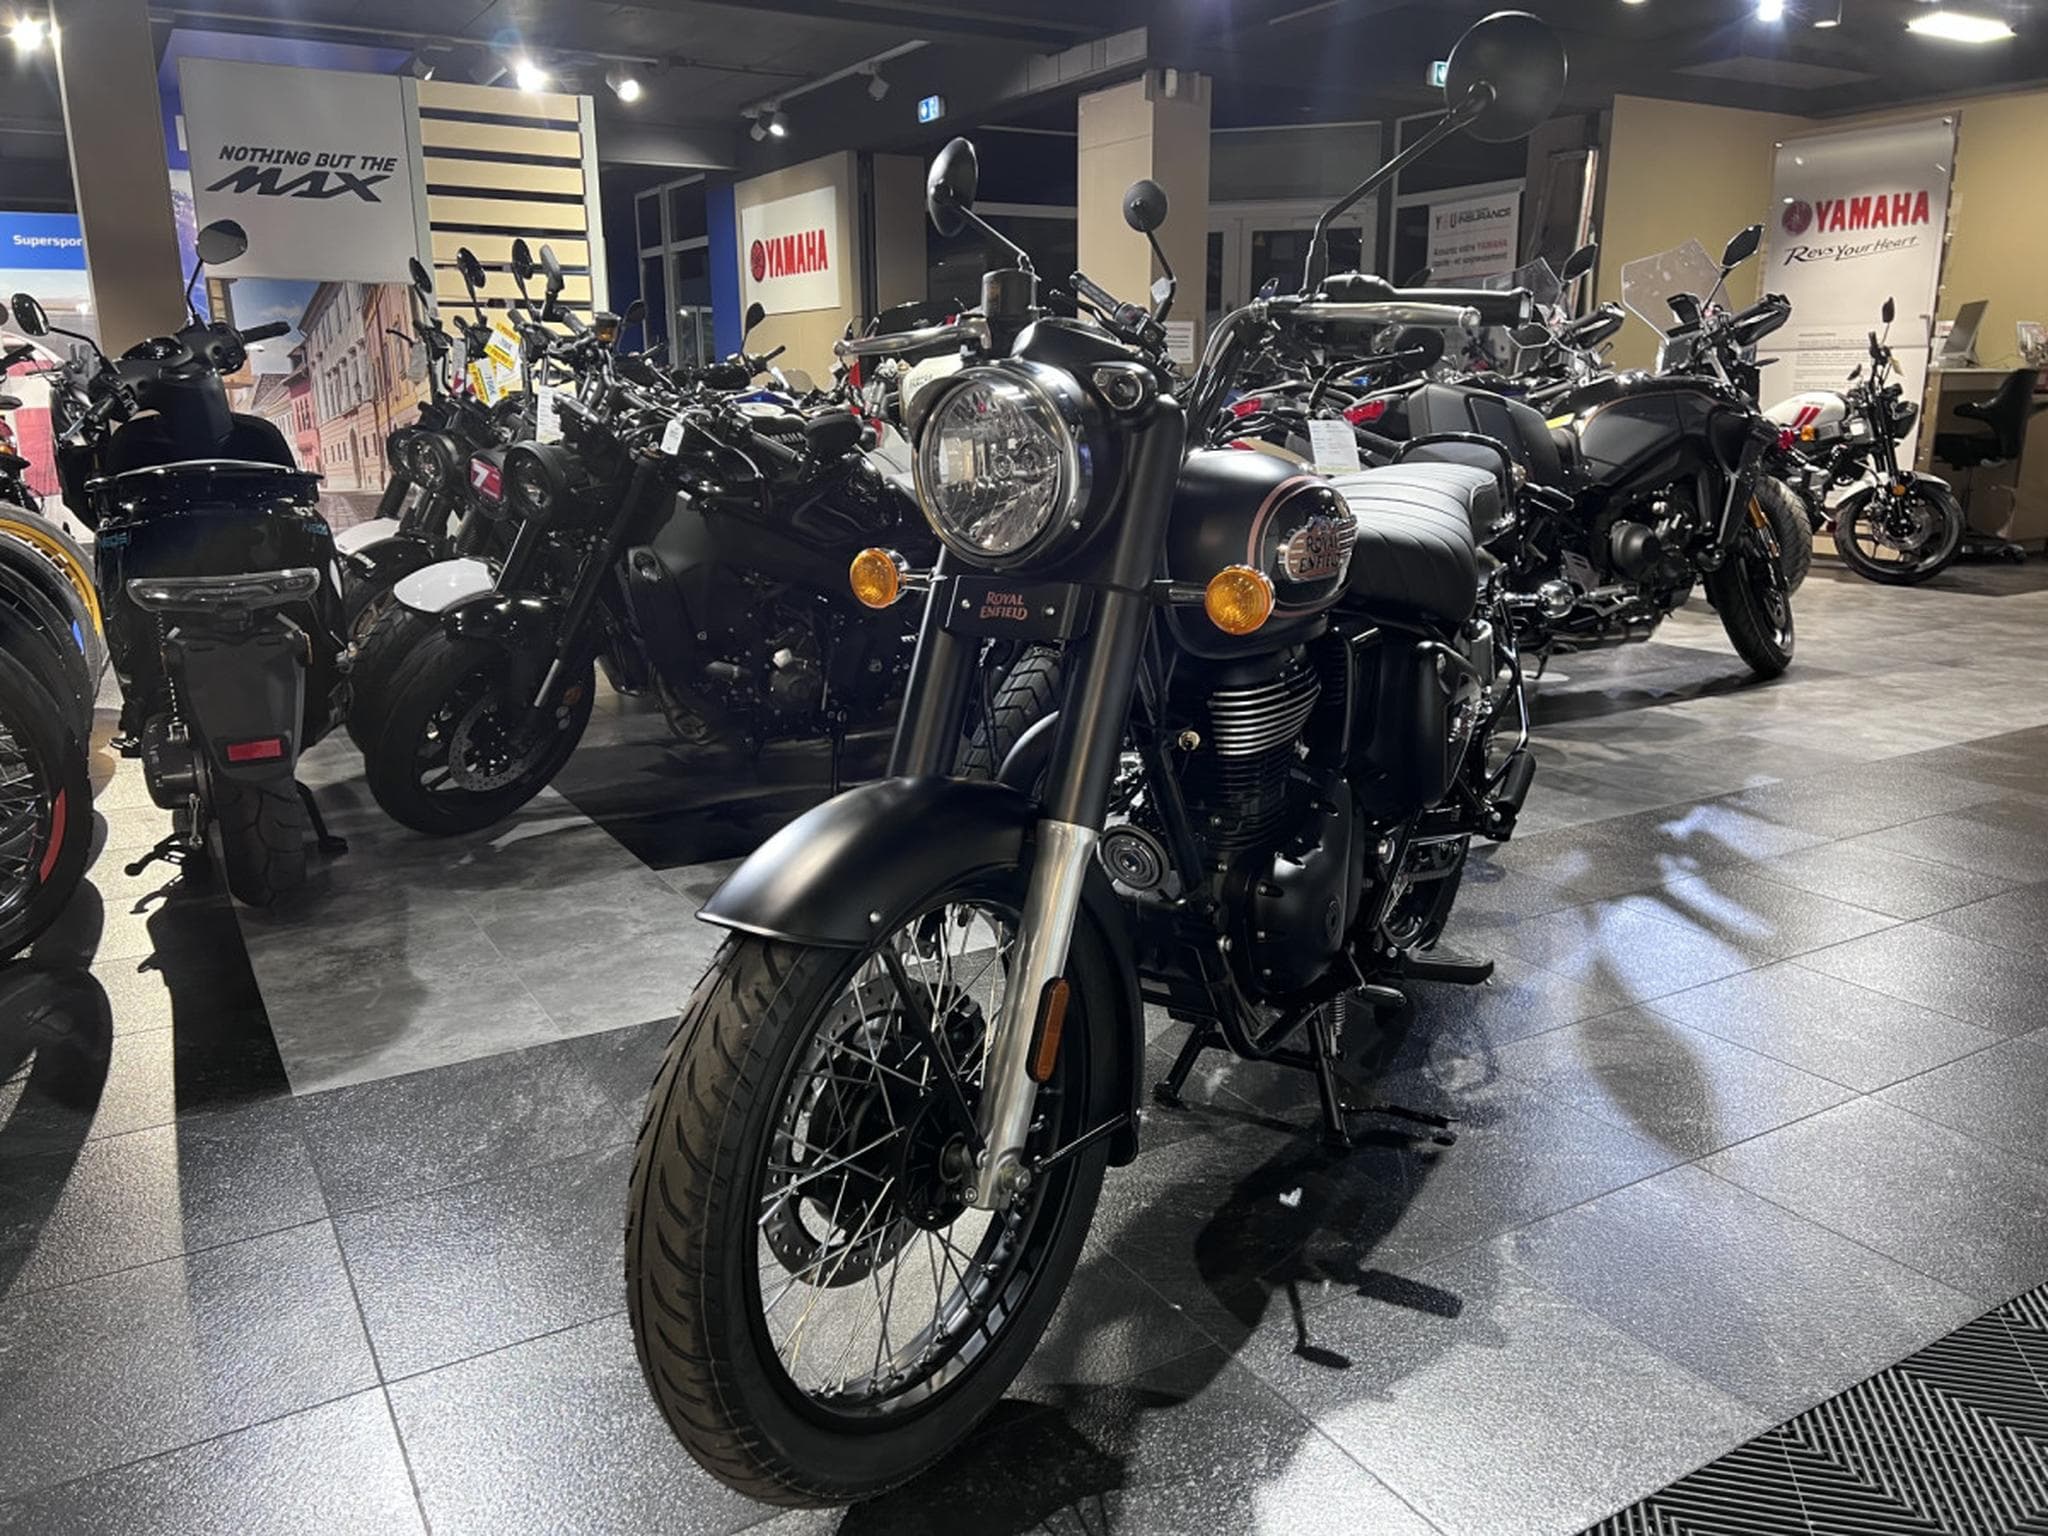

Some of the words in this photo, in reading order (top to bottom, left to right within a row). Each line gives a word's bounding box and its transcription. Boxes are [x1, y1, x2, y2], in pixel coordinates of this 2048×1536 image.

[218, 145, 311, 166] NOTHING
[315, 153, 356, 169] BUT
[360, 156, 398, 172] THE
[205, 166, 391, 203] MAX
[1815, 190, 1929, 233] YAMAHA
[765, 229, 828, 278] YAMAHA
[1783, 245, 1833, 265] Revs
[1835, 243, 1873, 261] Your
[1873, 236, 1918, 250] Heart
[980, 606, 1028, 620] ENFIELD
[985, 591, 1025, 606] ROYAL
